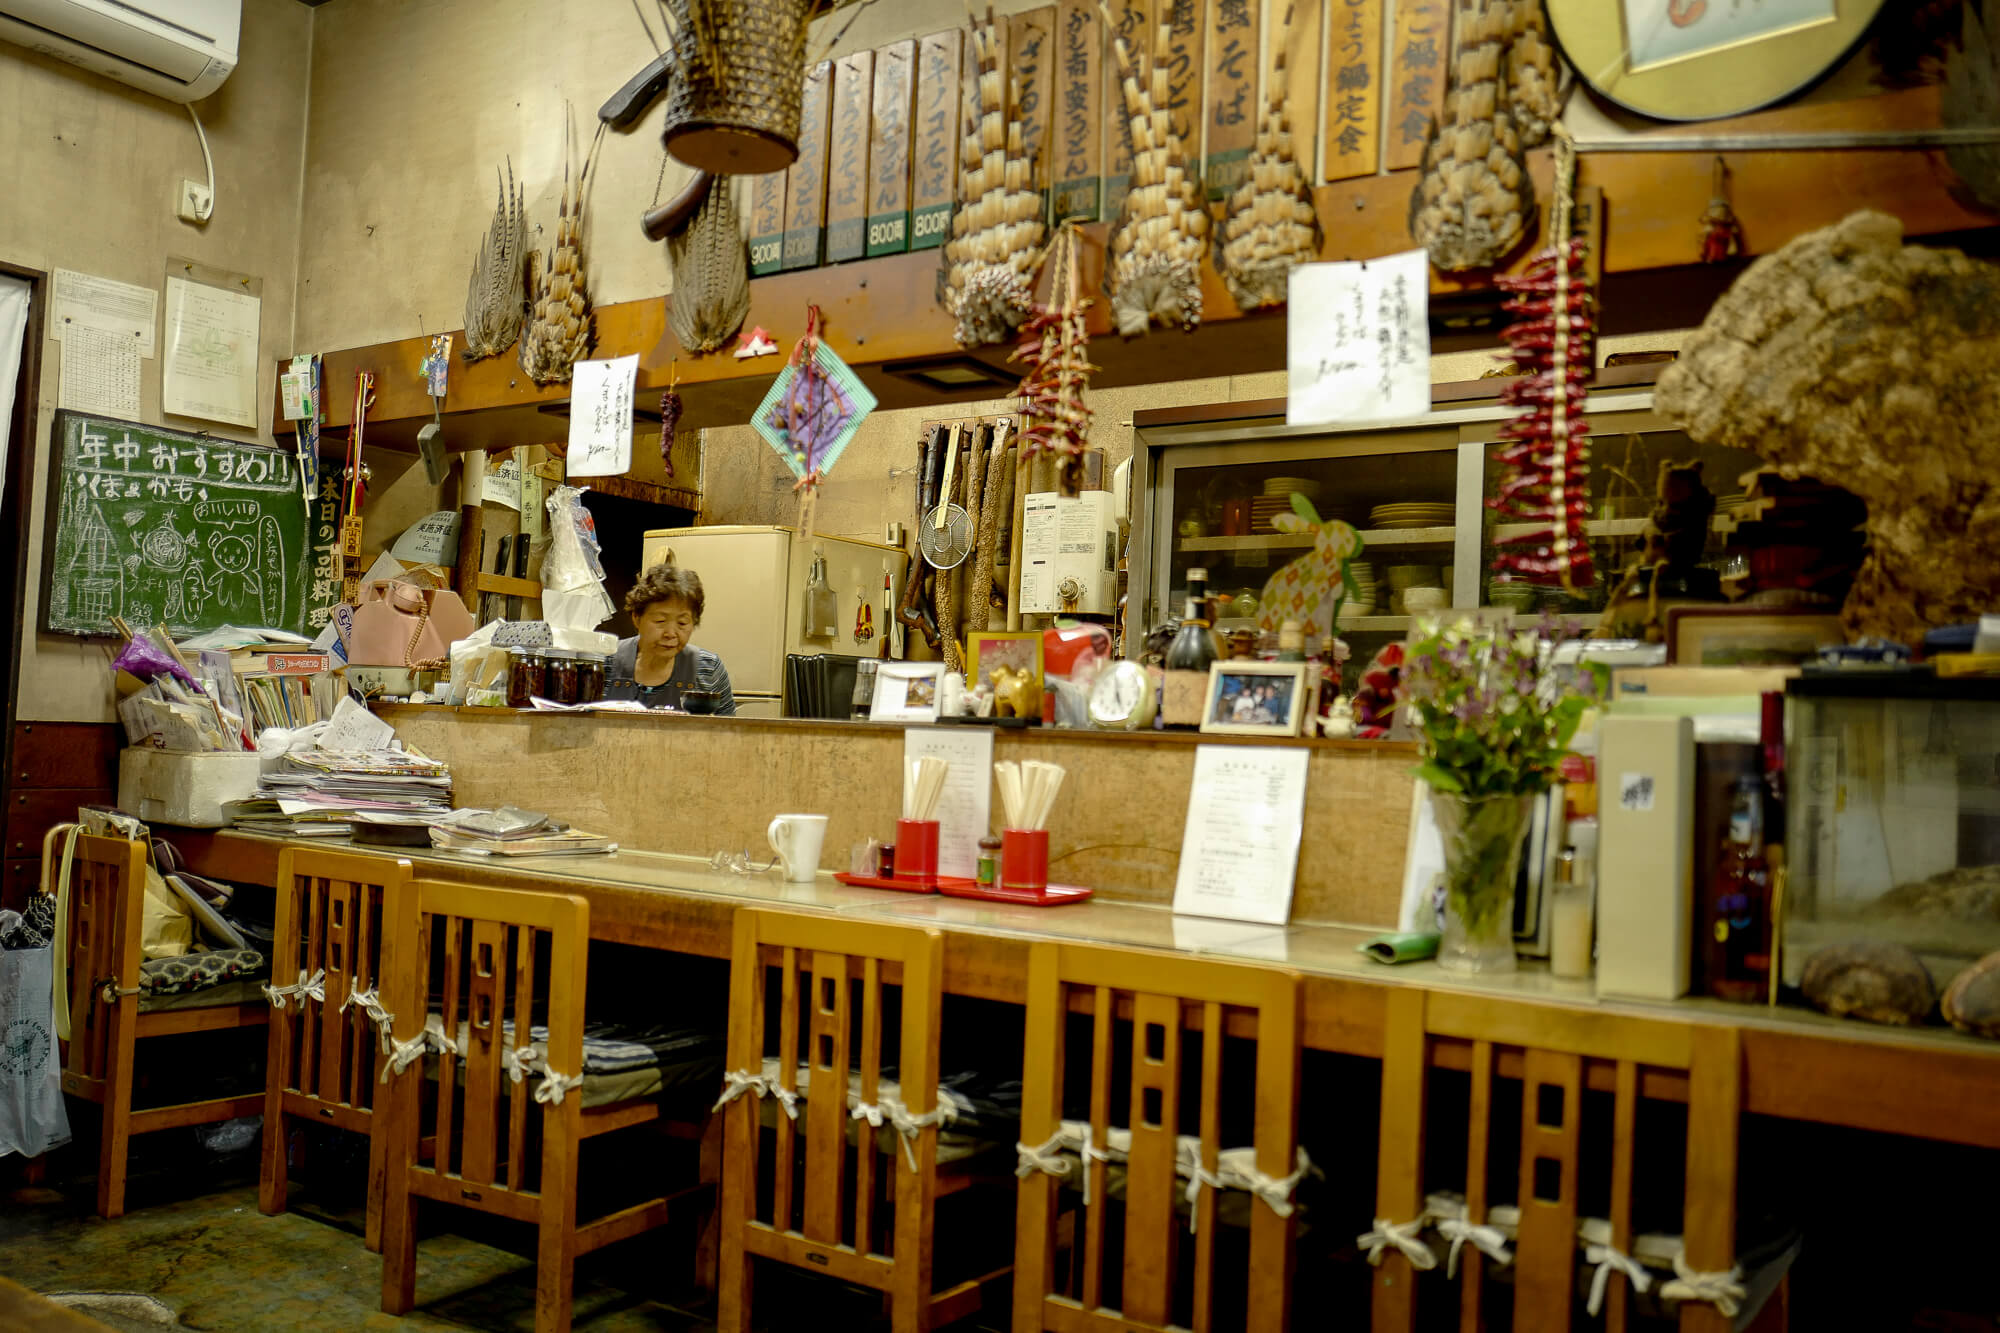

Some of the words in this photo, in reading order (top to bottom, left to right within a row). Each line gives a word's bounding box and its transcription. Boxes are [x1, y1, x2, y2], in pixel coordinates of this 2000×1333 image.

[919, 55, 951, 198] キノコそば
[309, 476, 341, 629] 本日の一品料理
